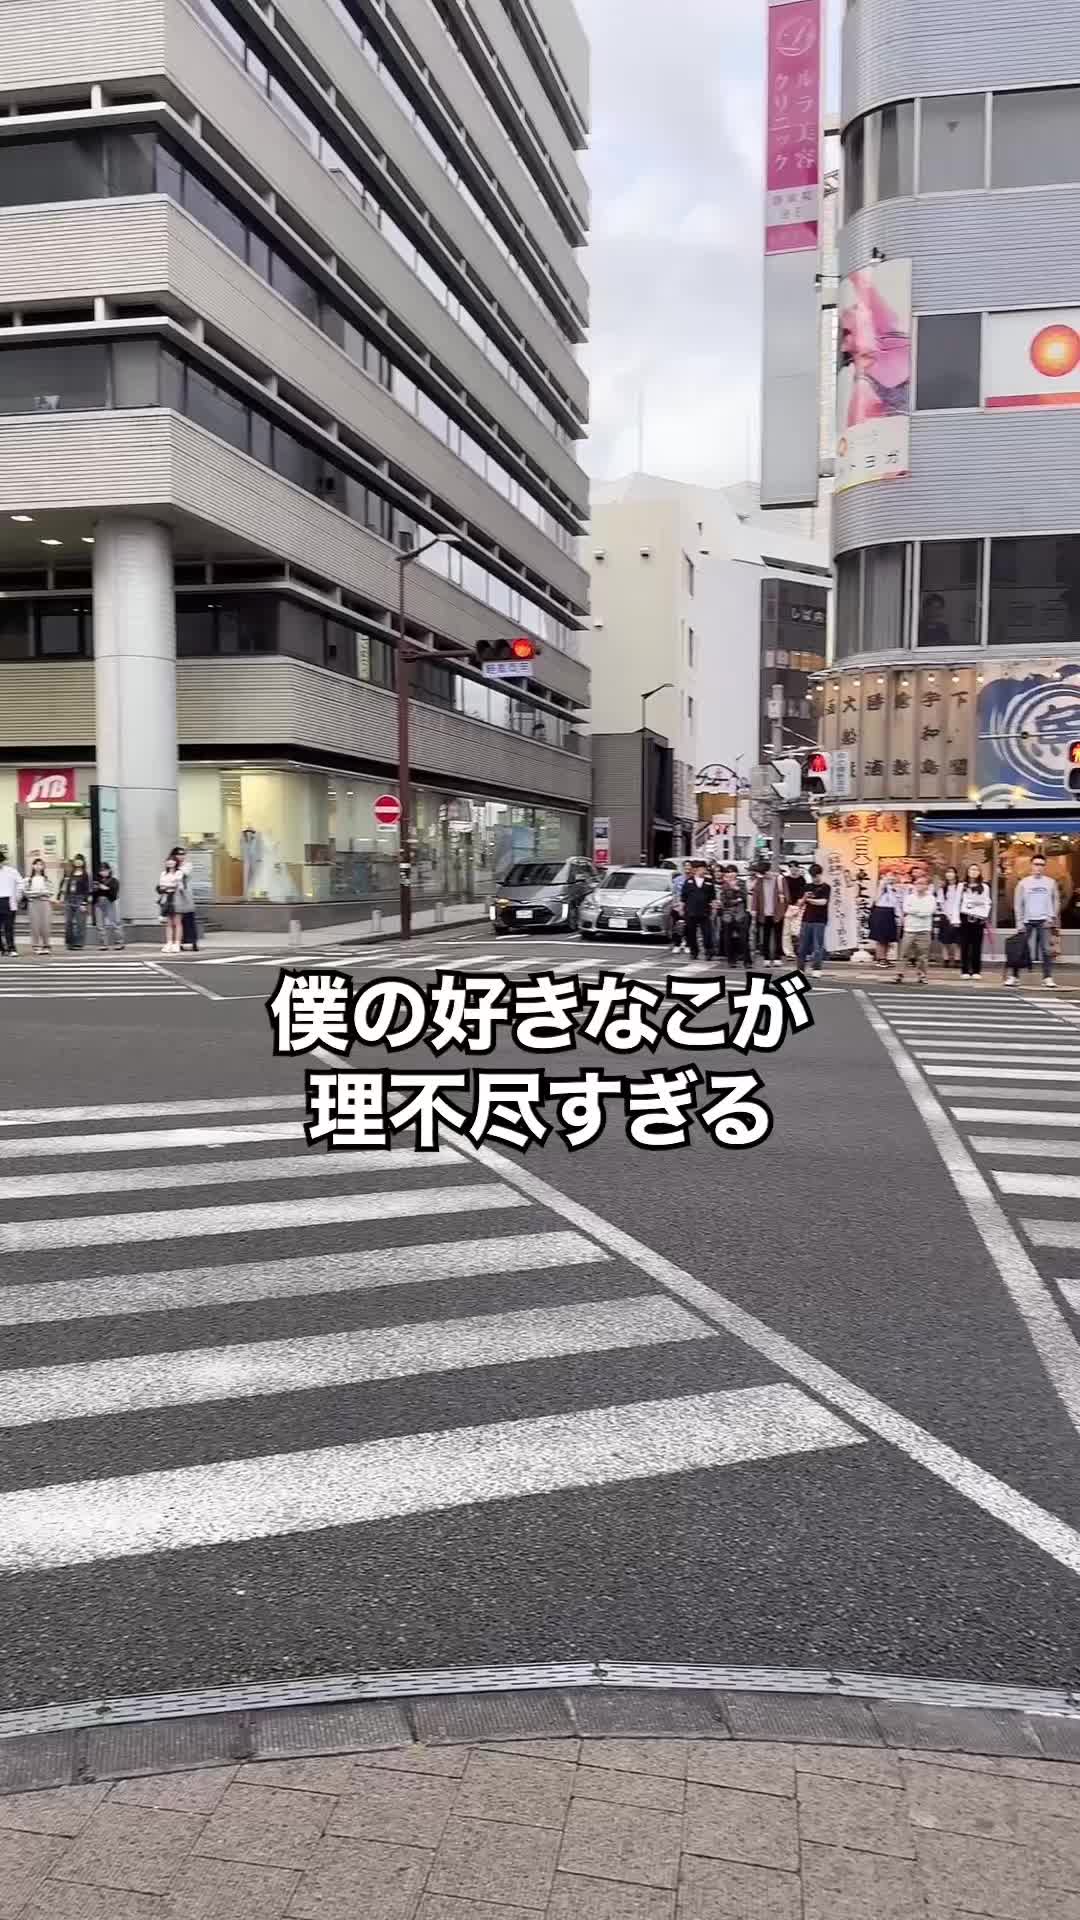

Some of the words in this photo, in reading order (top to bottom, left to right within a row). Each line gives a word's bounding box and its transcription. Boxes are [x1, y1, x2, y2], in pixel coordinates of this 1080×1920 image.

[770, 73, 791, 172] クリニック
[795, 70, 817, 169] ルラ美容
[25, 775, 68, 802] JTB
